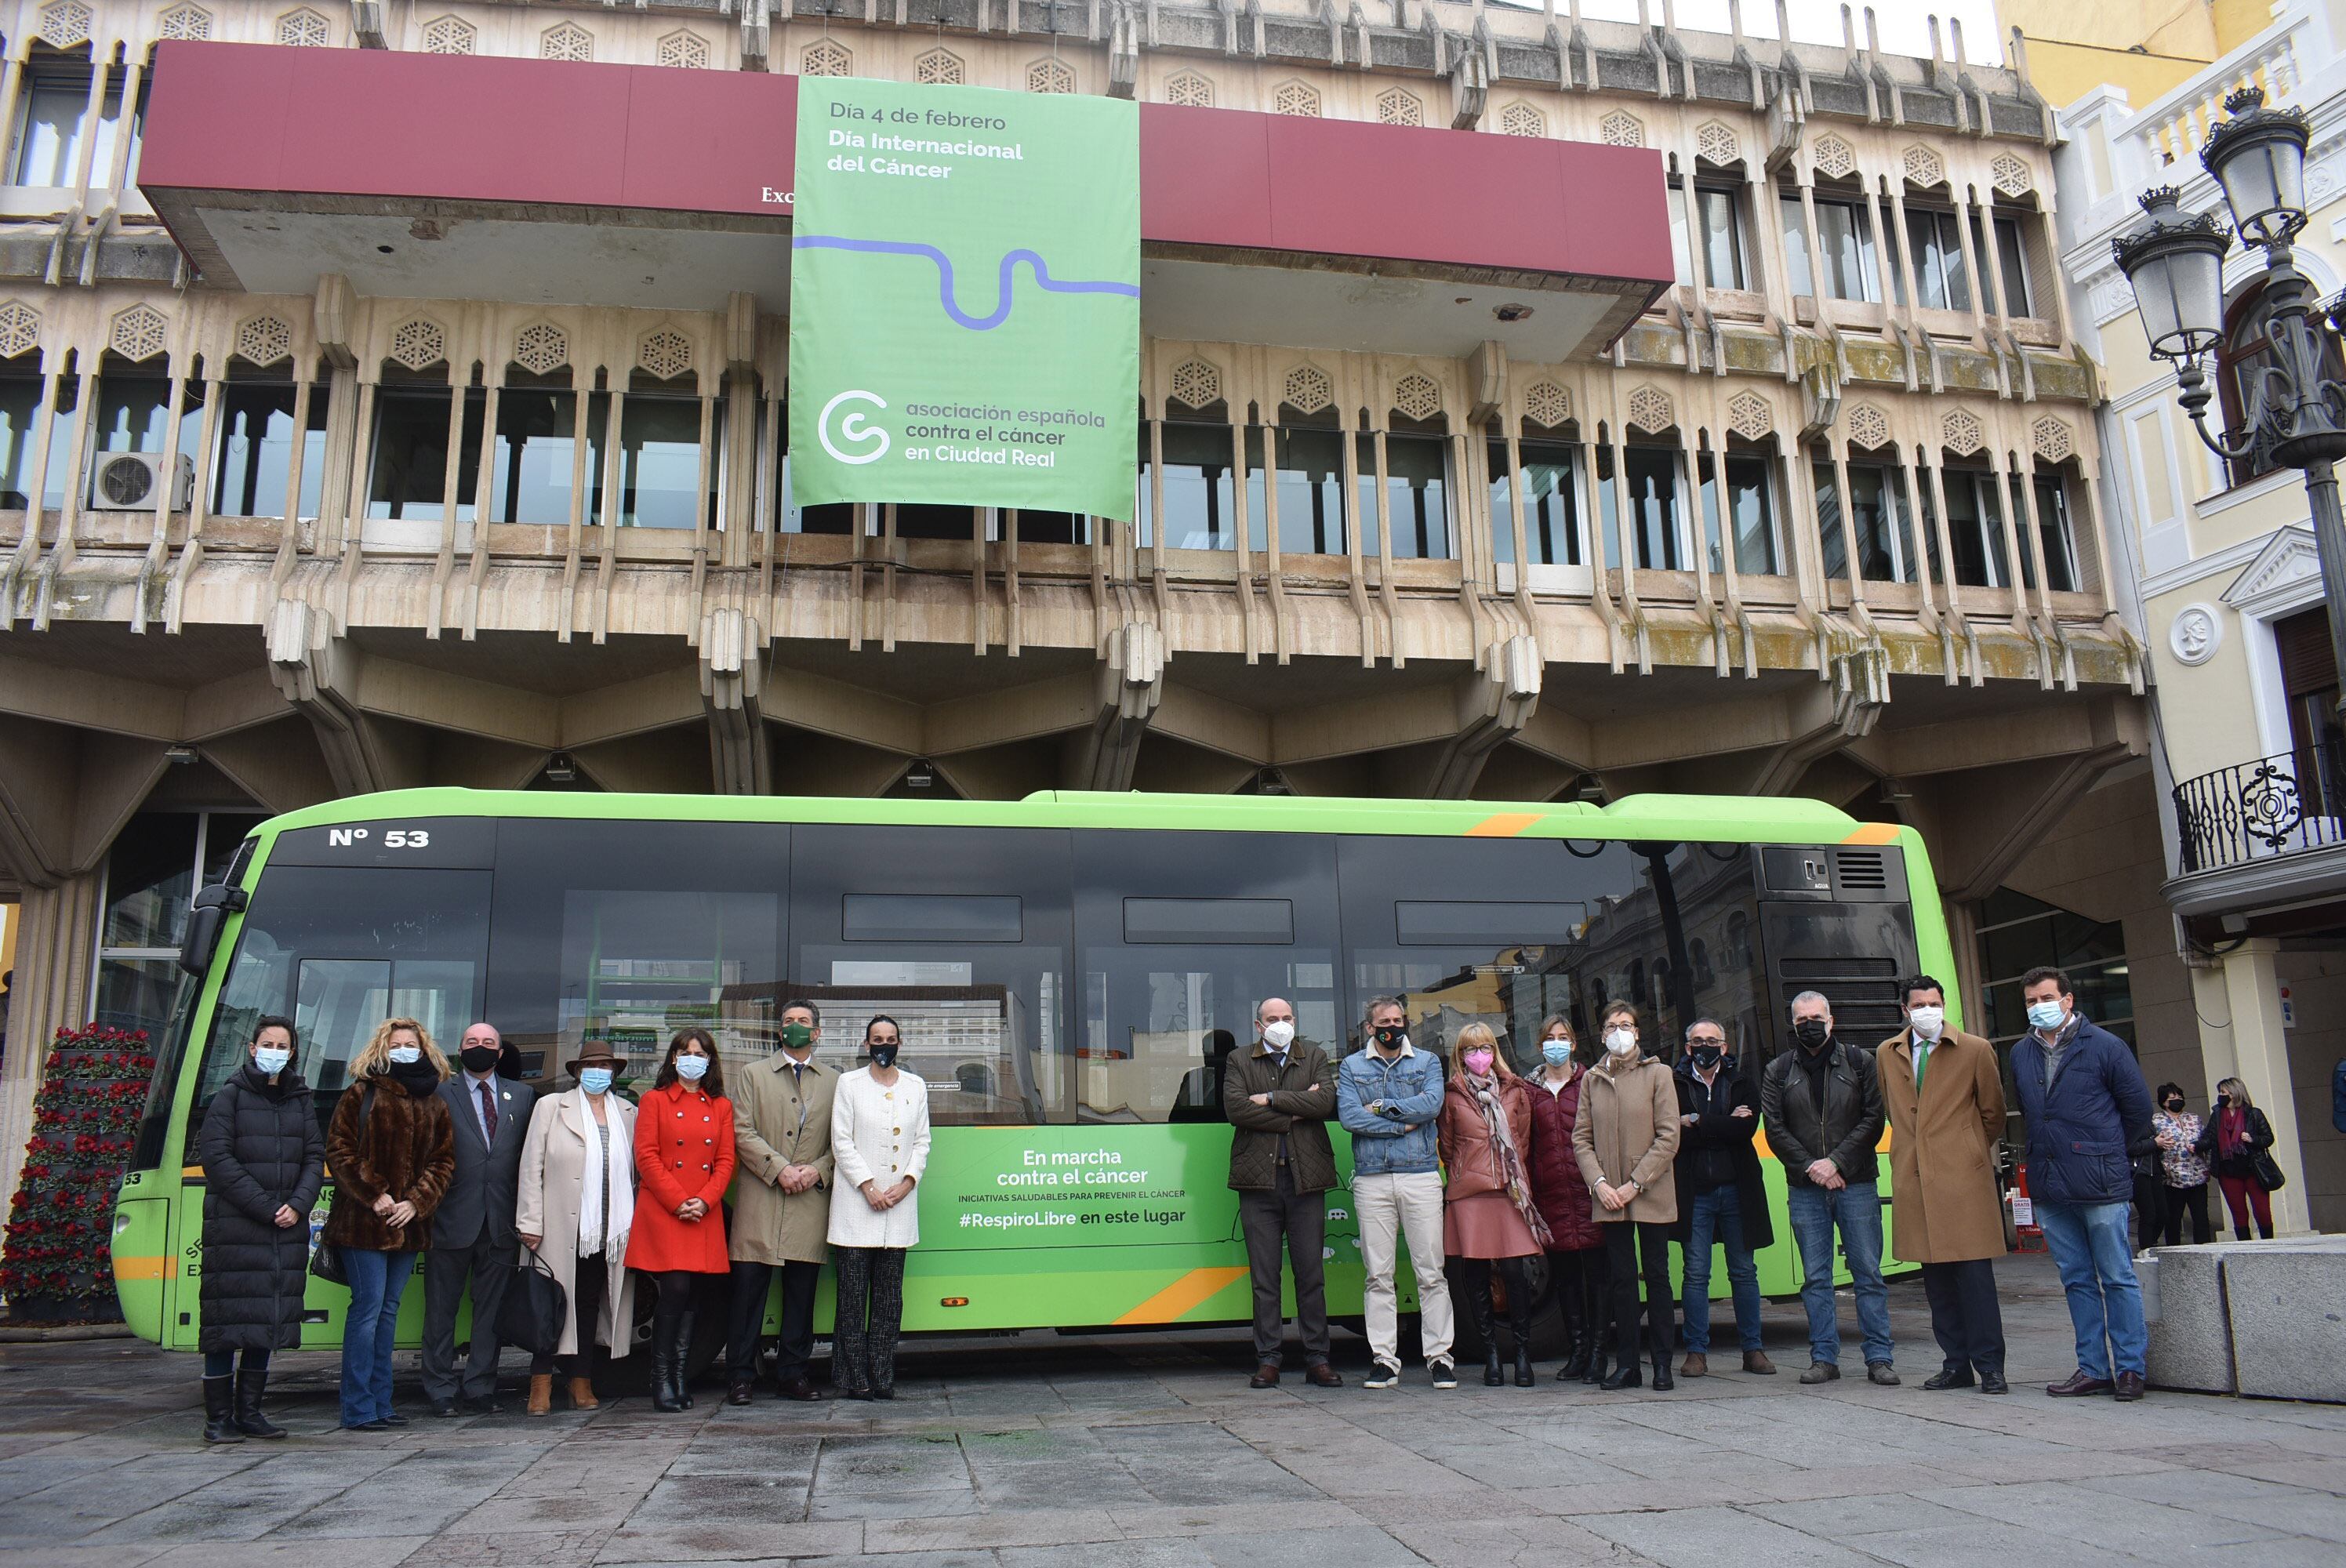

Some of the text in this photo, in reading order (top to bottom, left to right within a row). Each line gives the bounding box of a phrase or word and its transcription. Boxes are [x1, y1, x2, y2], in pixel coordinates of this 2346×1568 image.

[830, 102, 1006, 130] Día 4 de febrero
[829, 129, 1023, 160] Día Internacional
[827, 154, 953, 179] del Cáncer
[906, 402, 1106, 428] asociación española
[905, 424, 1066, 445] contra el cáncer
[904, 445, 1055, 467] en Ciudad Real
[384, 830, 430, 848] 53
[1023, 1148, 1122, 1166] En marcha
[125, 1173, 142, 1185] 53
[997, 1167, 1149, 1186] contra el cáncer
[958, 1194, 1010, 1203] INICIATIVAS
[1011, 1192, 1068, 1202] SALUDABLES
[1070, 1192, 1093, 1200] PARA
[1094, 1191, 1137, 1200] PREVENIR
[1150, 1188, 1186, 1199] CÁNCER
[959, 1208, 1186, 1230] #RespiroLibre en este lugar
